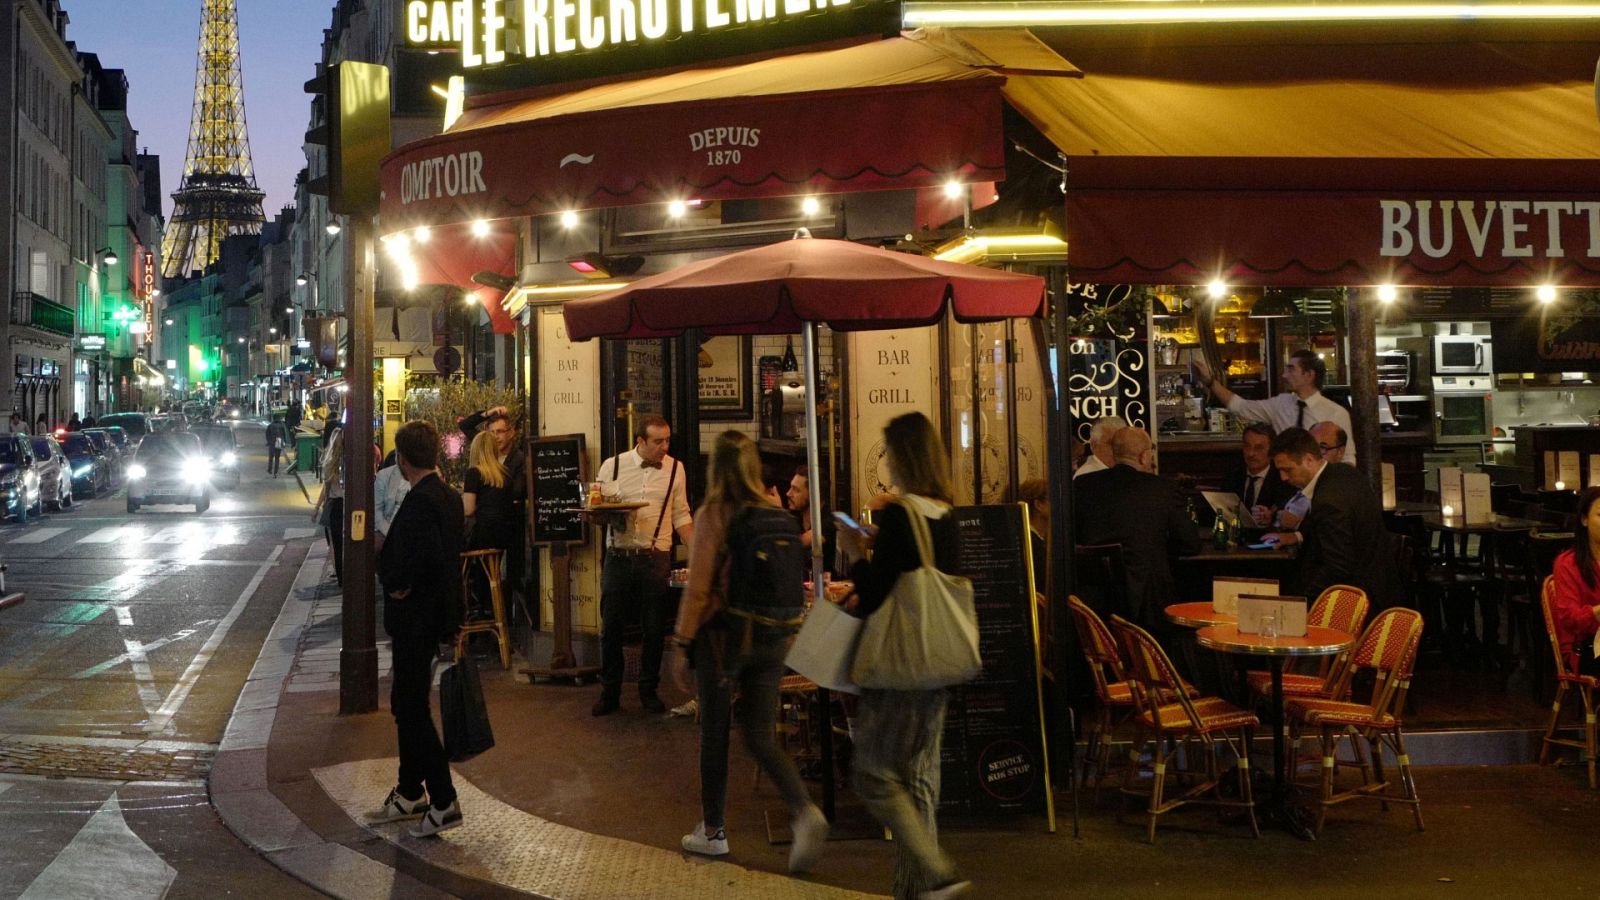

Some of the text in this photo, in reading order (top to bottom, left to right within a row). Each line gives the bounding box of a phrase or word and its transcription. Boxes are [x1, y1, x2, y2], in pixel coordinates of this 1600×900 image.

[463, 0, 505, 68] LE
[689, 127, 760, 152] DEPUIS
[707, 150, 741, 166] 1870
[401, 150, 487, 205] COMPTOIR
[145, 254, 153, 343] THOUMIEUX
[557, 359, 579, 372] BAR
[877, 349, 911, 366] BAR
[553, 393, 584, 405] GRILL
[869, 388, 915, 404] GRILL
